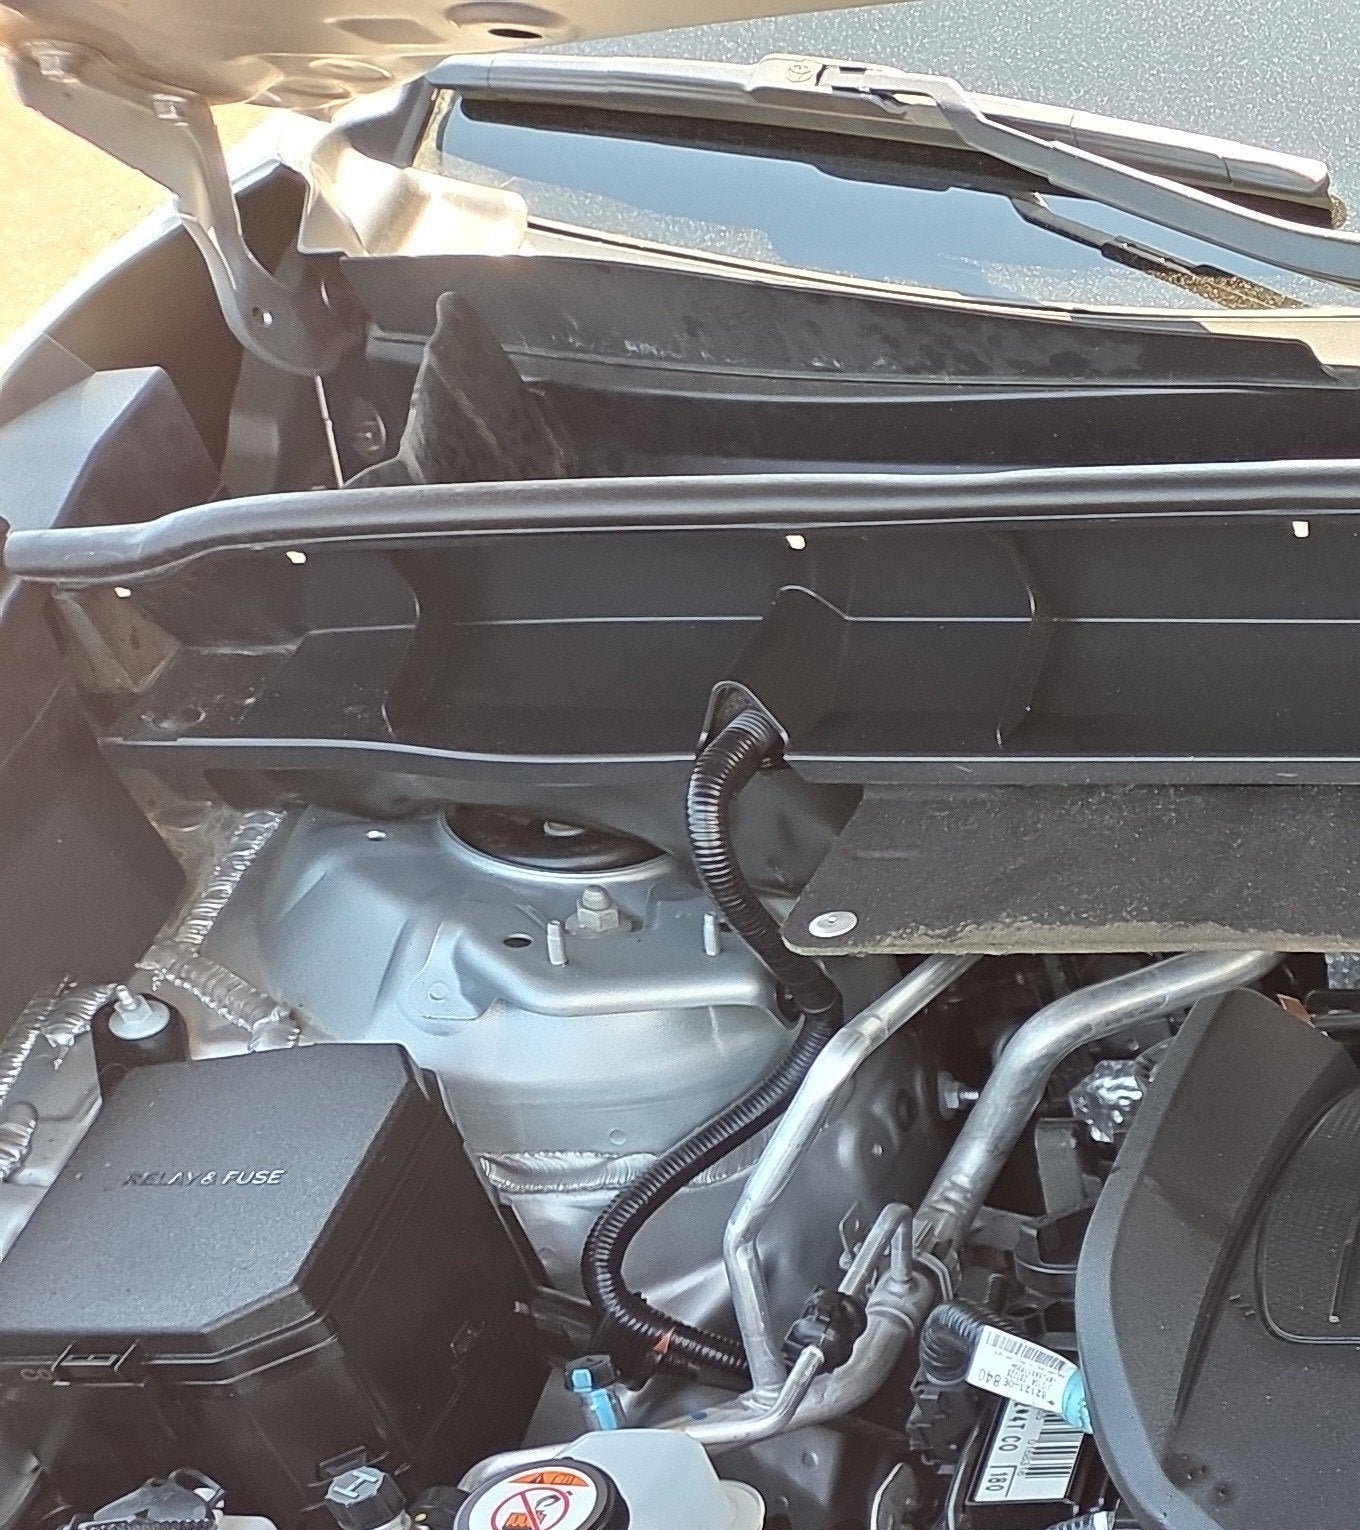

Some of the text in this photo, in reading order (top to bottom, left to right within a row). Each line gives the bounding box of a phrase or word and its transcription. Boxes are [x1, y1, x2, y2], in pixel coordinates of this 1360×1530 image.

[123, 1170, 287, 1187] RELAY & FUSE
